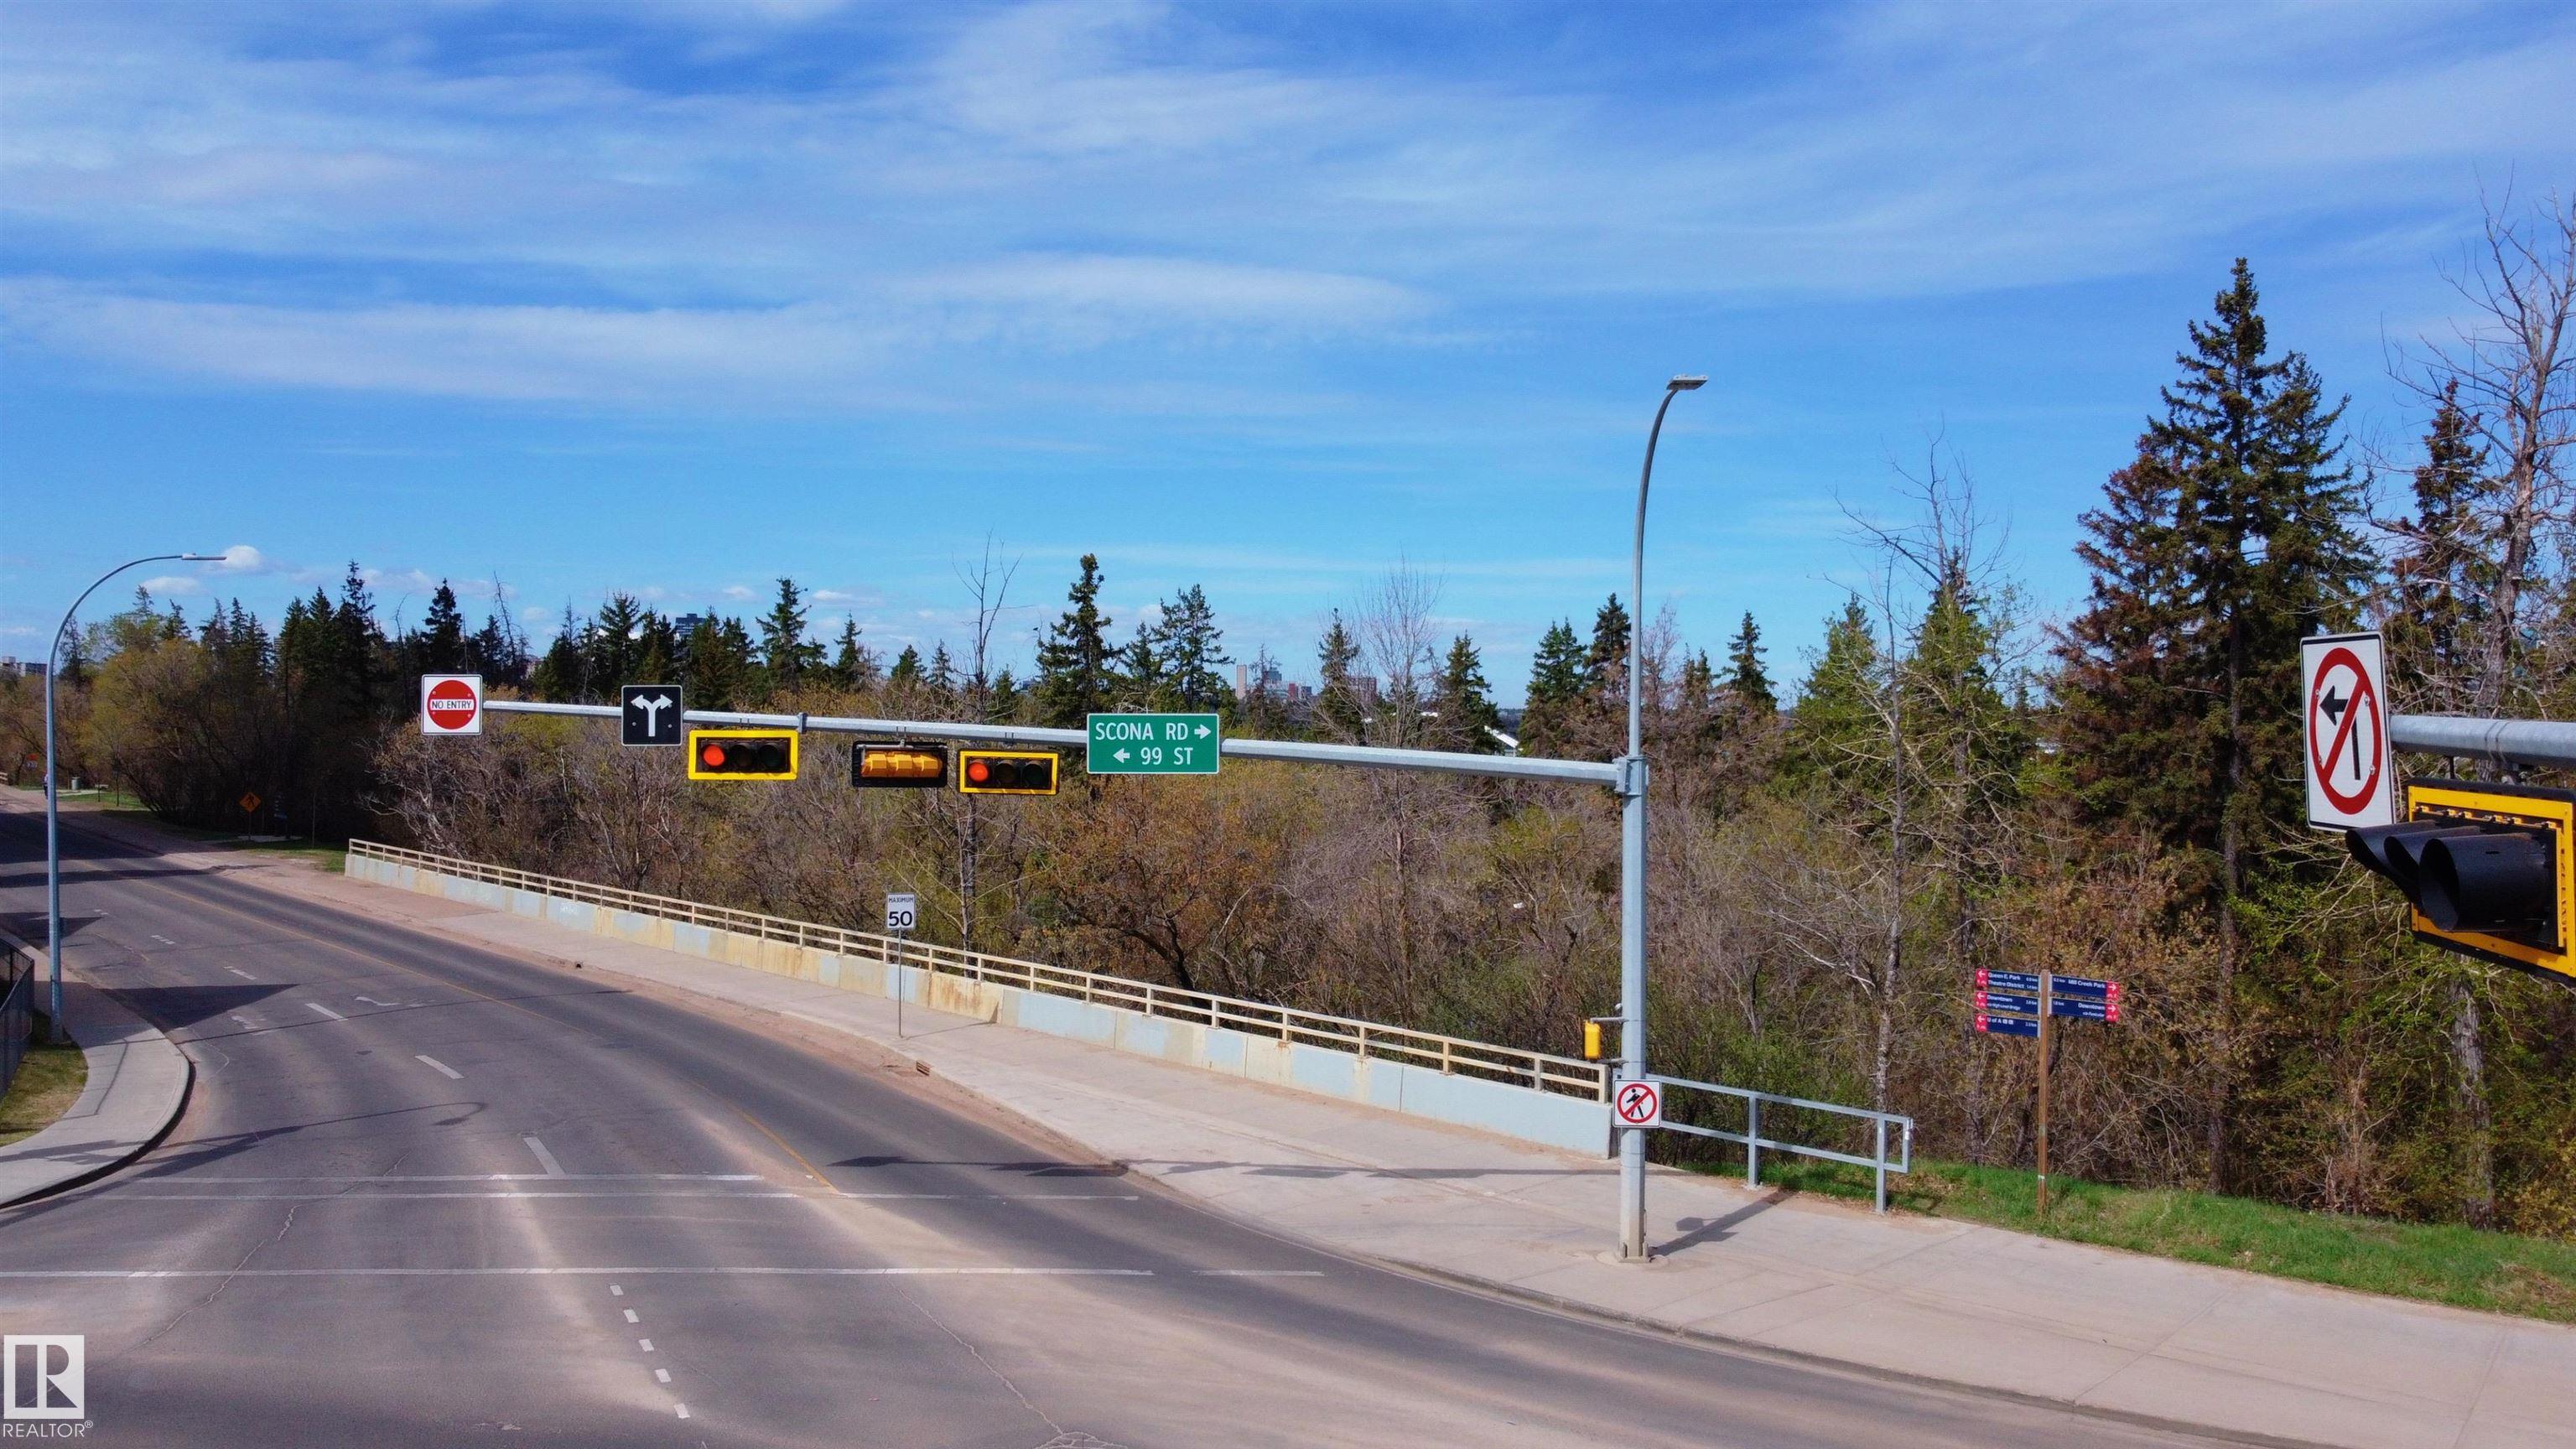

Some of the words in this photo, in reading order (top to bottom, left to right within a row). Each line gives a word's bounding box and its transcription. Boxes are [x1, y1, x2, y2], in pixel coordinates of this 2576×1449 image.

[432, 700, 444, 709] NO
[447, 700, 471, 709] ENTRY
[1095, 722, 1154, 740] SCONA
[1166, 722, 1188, 740] RD
[1140, 746, 1162, 766] 99
[1174, 746, 1193, 766] ST
[889, 911, 913, 927] 50
